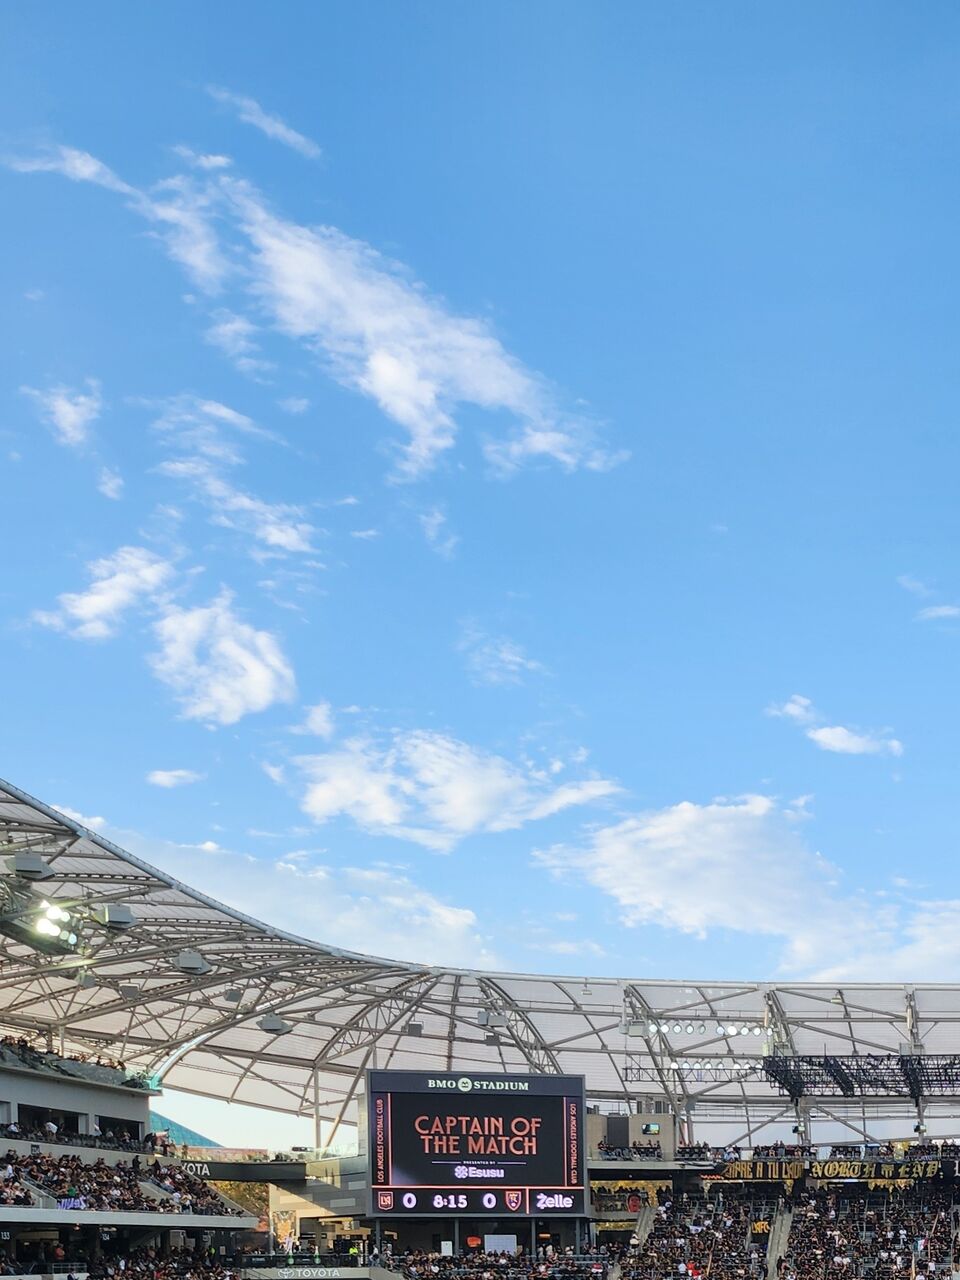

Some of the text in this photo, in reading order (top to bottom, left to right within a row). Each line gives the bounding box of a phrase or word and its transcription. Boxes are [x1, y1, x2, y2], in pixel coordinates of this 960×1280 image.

[428, 1079, 529, 1091] BMO STADIUM
[415, 1115, 541, 1136] CAPTAIN OF
[420, 1135, 537, 1155] THE MATCH
[469, 1166, 504, 1178] Esusu
[403, 1193, 417, 1208] 0
[433, 1195, 468, 1208] 8:15
[483, 1193, 497, 1208] 0
[536, 1194, 573, 1209] Zelle
[296, 1269, 340, 1277] TOYOTA
